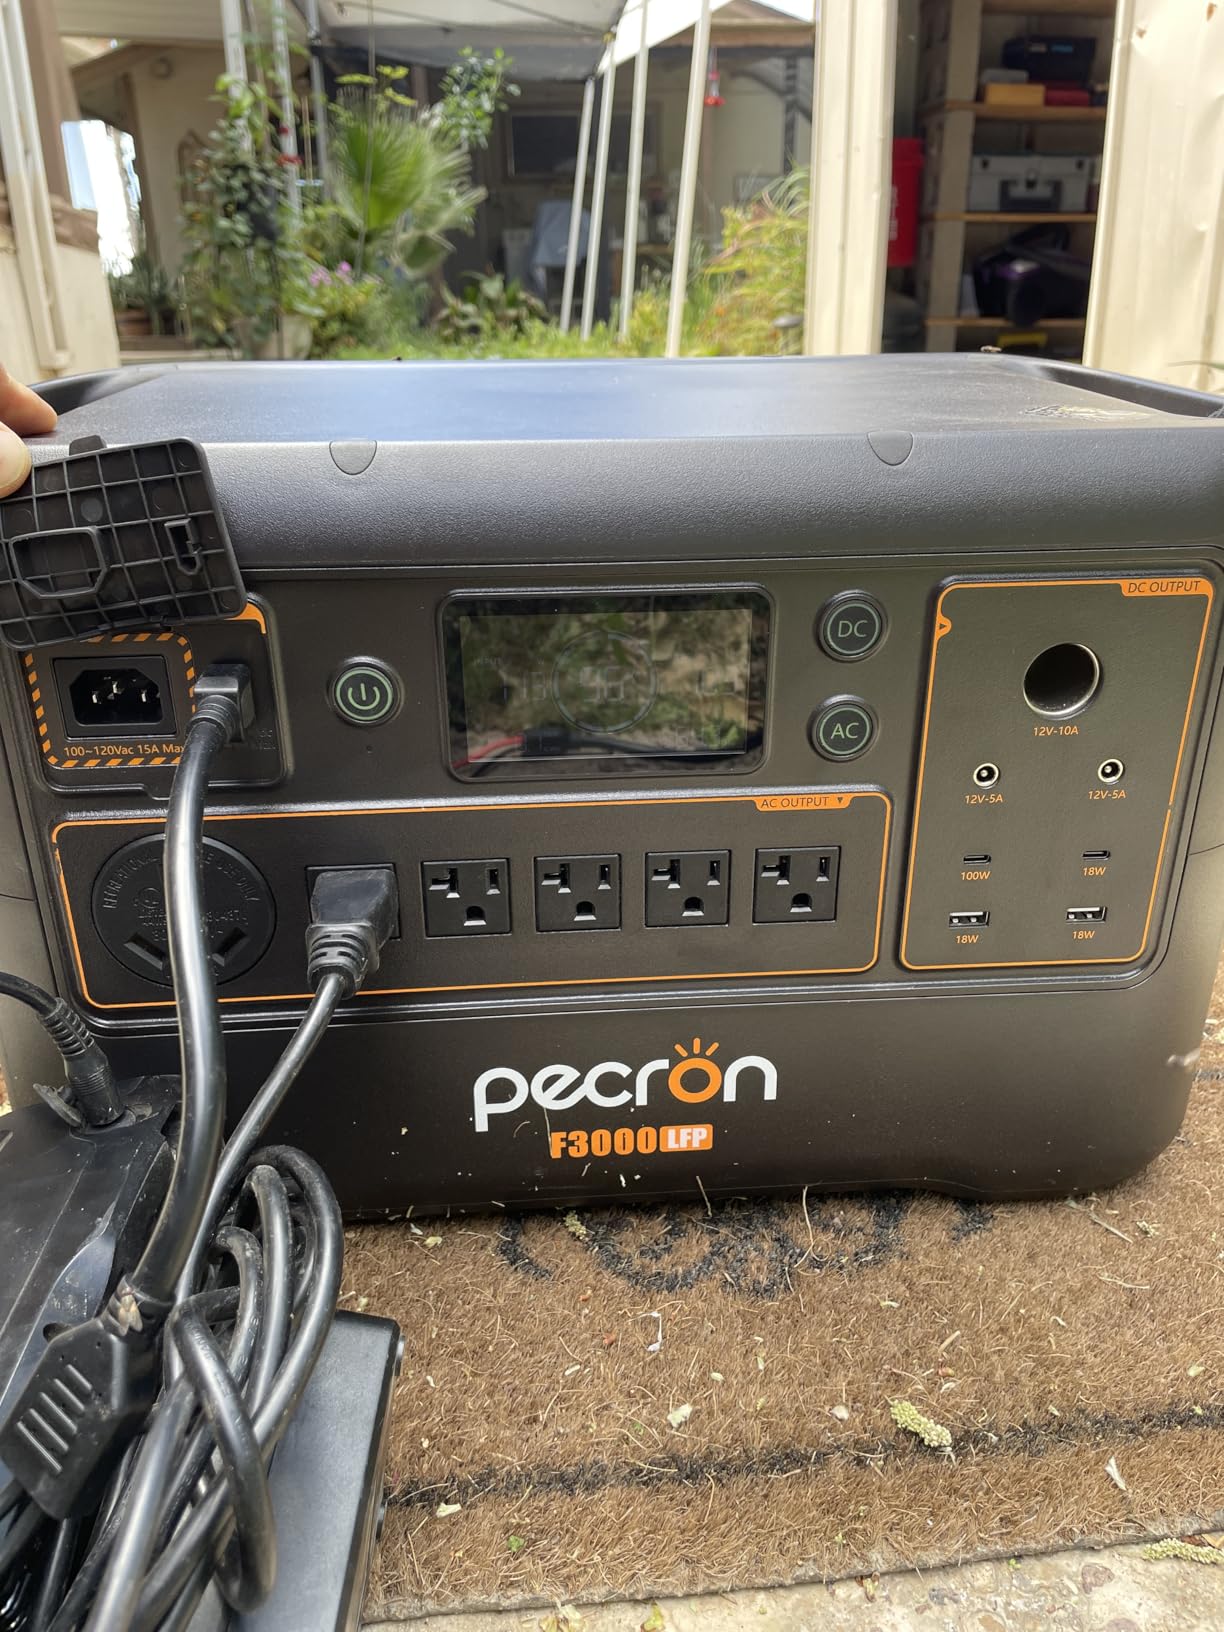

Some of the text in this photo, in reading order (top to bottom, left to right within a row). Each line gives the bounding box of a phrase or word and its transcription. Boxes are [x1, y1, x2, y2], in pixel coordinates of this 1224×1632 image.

[1128, 580, 1201, 593] DC OUTPUT
[837, 619, 868, 638] DC
[830, 722, 860, 740] AC
[1033, 725, 1080, 737] 12V-10A
[137, 744, 160, 754] 15A
[964, 794, 1004, 805] 12V-5A
[1088, 790, 1127, 801] 12V-5A
[761, 796, 830, 809] AC OUTPUT
[960, 869, 992, 882] 100W
[1082, 866, 1107, 877] 18W
[955, 934, 980, 945] 18W
[1072, 929, 1096, 941] 18W
[473, 1050, 778, 1132] pecron
[550, 1126, 709, 1159] F3000 LFP
